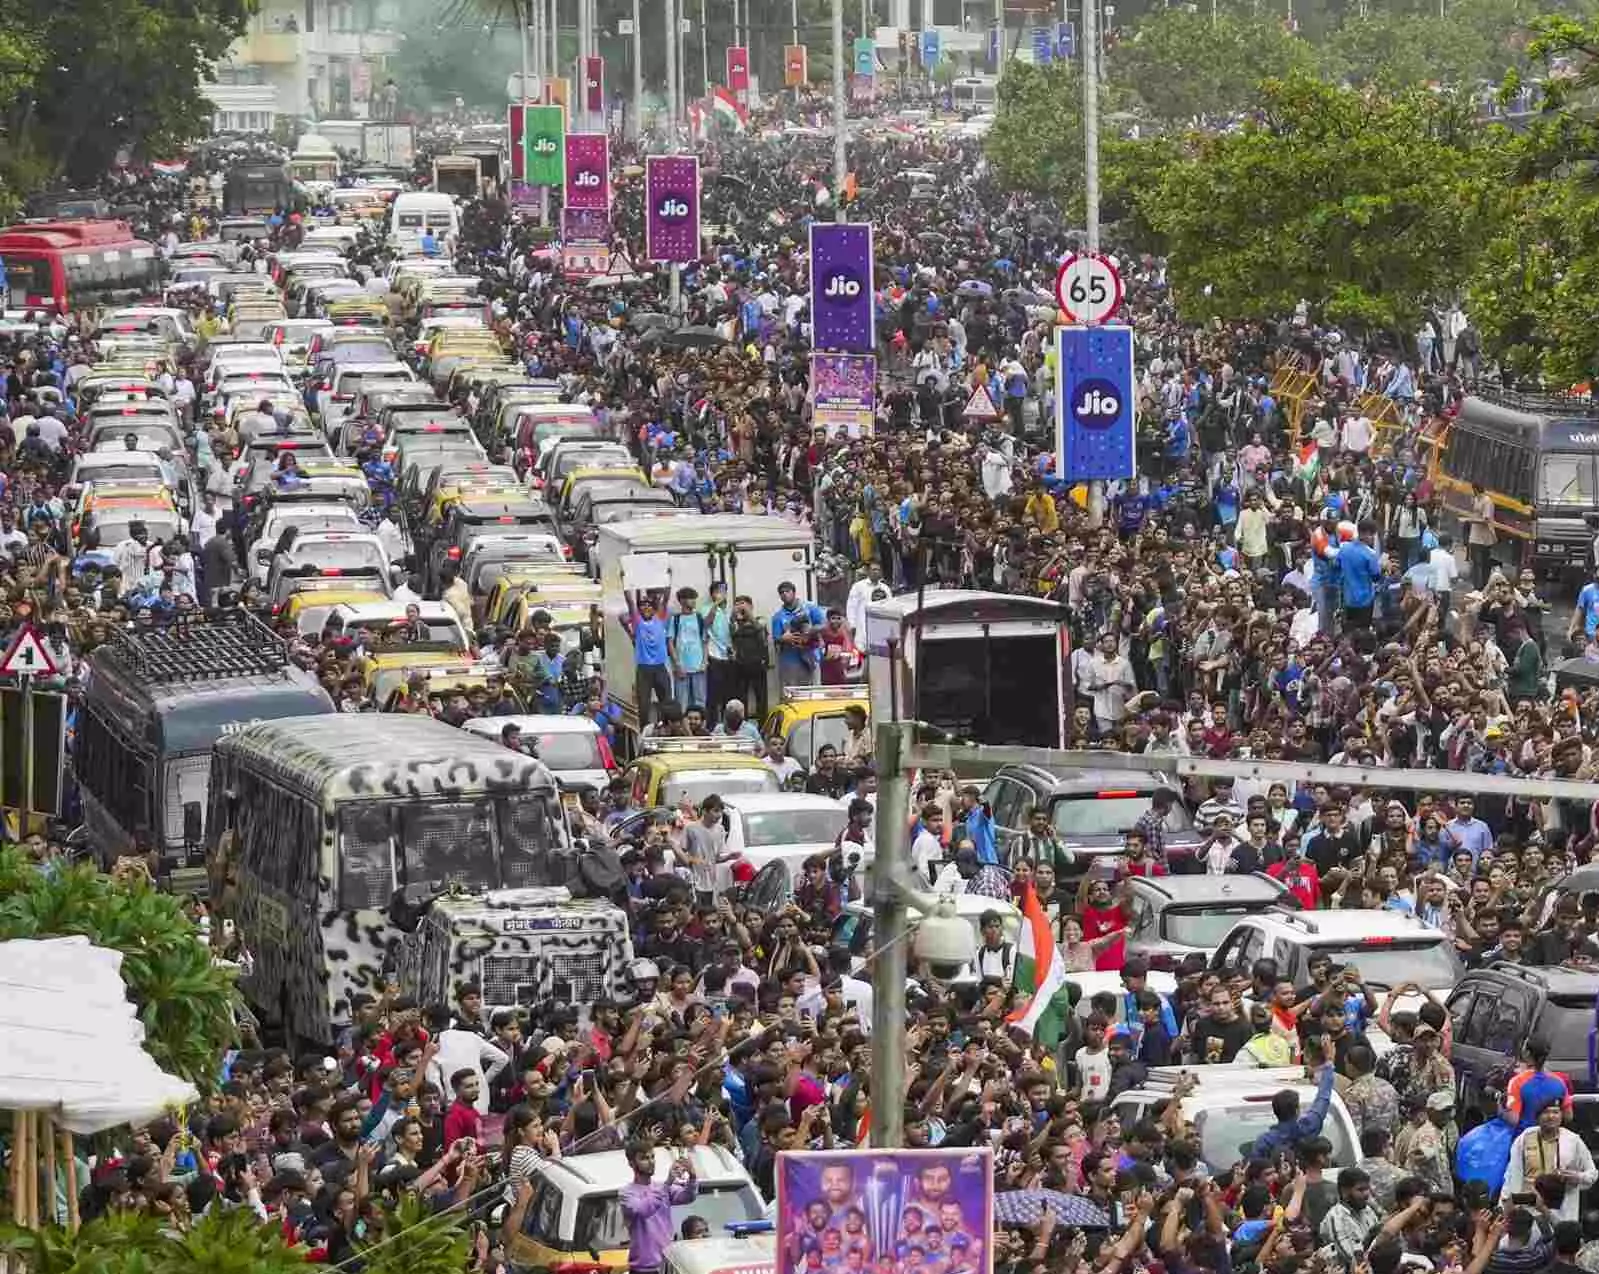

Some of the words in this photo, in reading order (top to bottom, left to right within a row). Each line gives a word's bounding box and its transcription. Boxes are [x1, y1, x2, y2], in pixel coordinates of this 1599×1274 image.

[534, 138, 557, 152] Jio
[575, 170, 600, 186] Jio
[659, 199, 689, 216] Jio
[825, 276, 860, 297] Jio
[1069, 275, 1107, 304] 65
[1076, 389, 1119, 416] Jio
